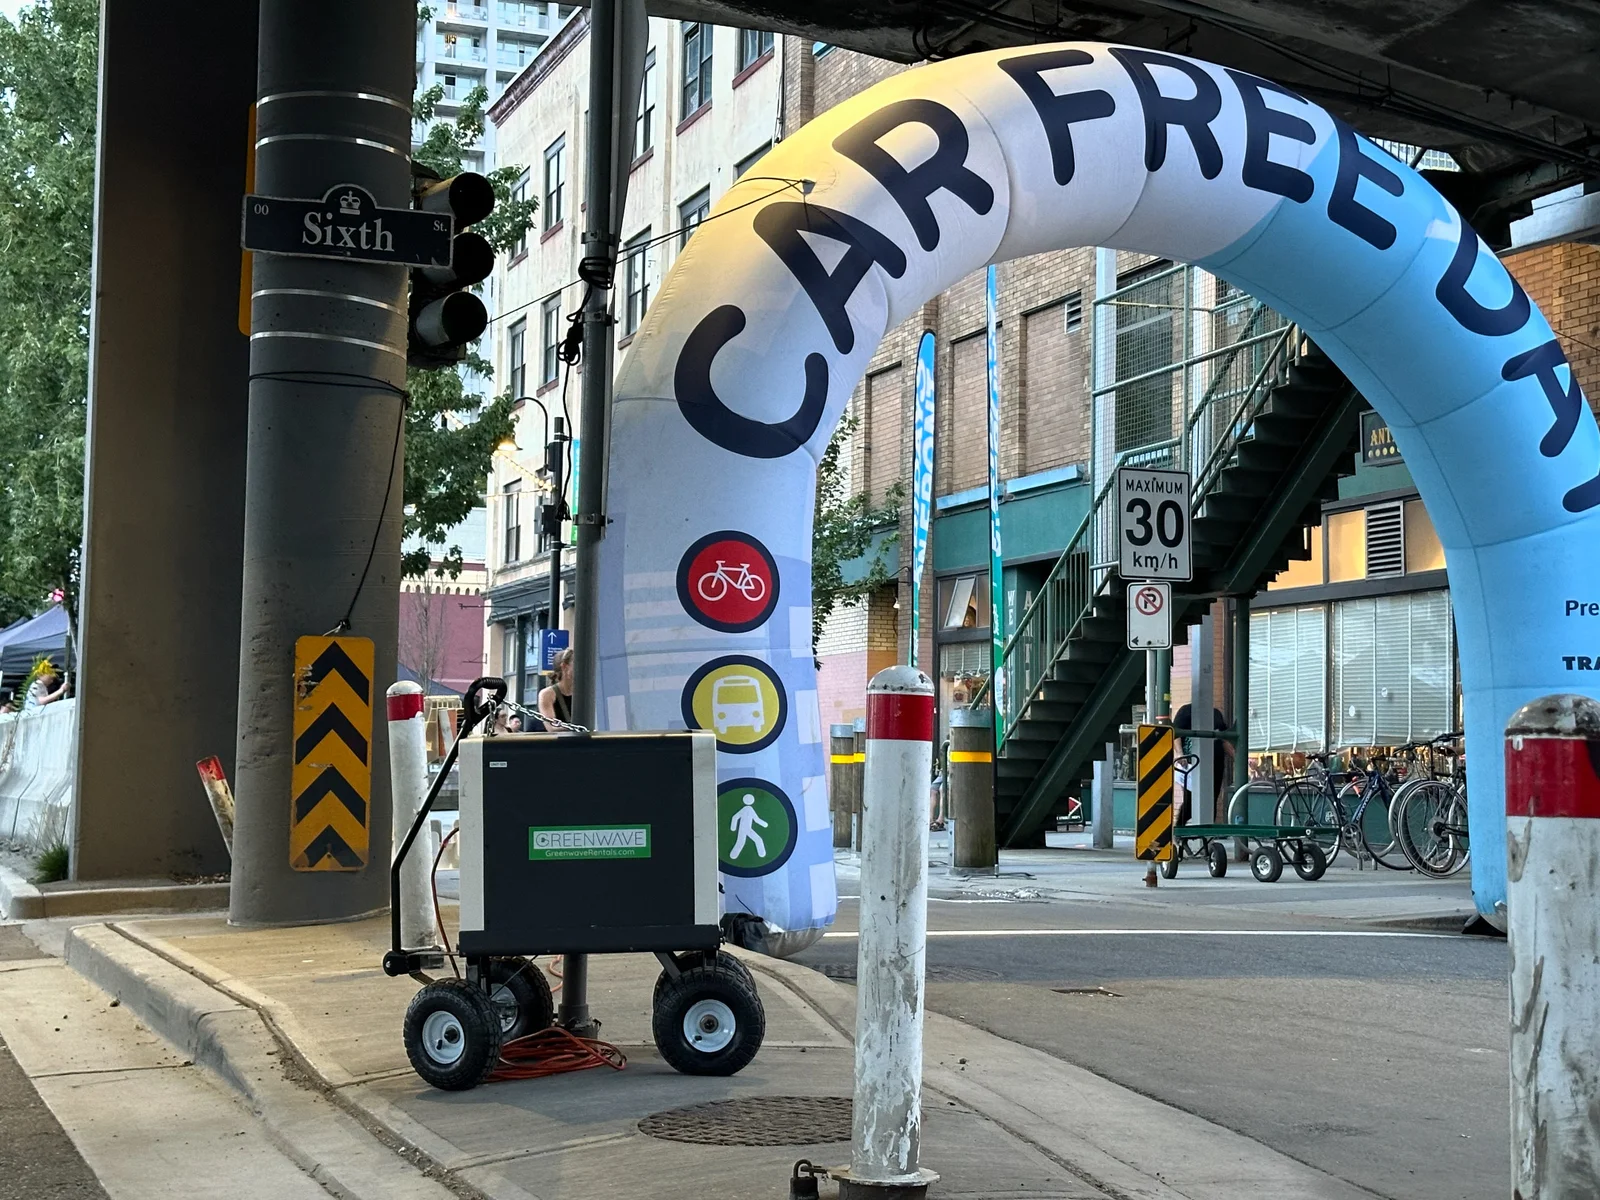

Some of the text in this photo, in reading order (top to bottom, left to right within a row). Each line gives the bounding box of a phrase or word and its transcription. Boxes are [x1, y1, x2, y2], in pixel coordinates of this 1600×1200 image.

[254, 203, 448, 252] 00 Sixth St.
[674, 98, 994, 459] CAR
[997, 47, 1404, 251] FREE
[1436, 215, 1600, 514] DA
[1370, 427, 1394, 446] ANT
[1126, 479, 1183, 495] MAXIMUM
[1125, 498, 1184, 548] 30
[1133, 551, 1178, 570] km/h
[1565, 600, 1600, 617] Pre
[536, 831, 644, 848] GREENWAVE
[545, 849, 635, 857] GreenwaveRentals.com
